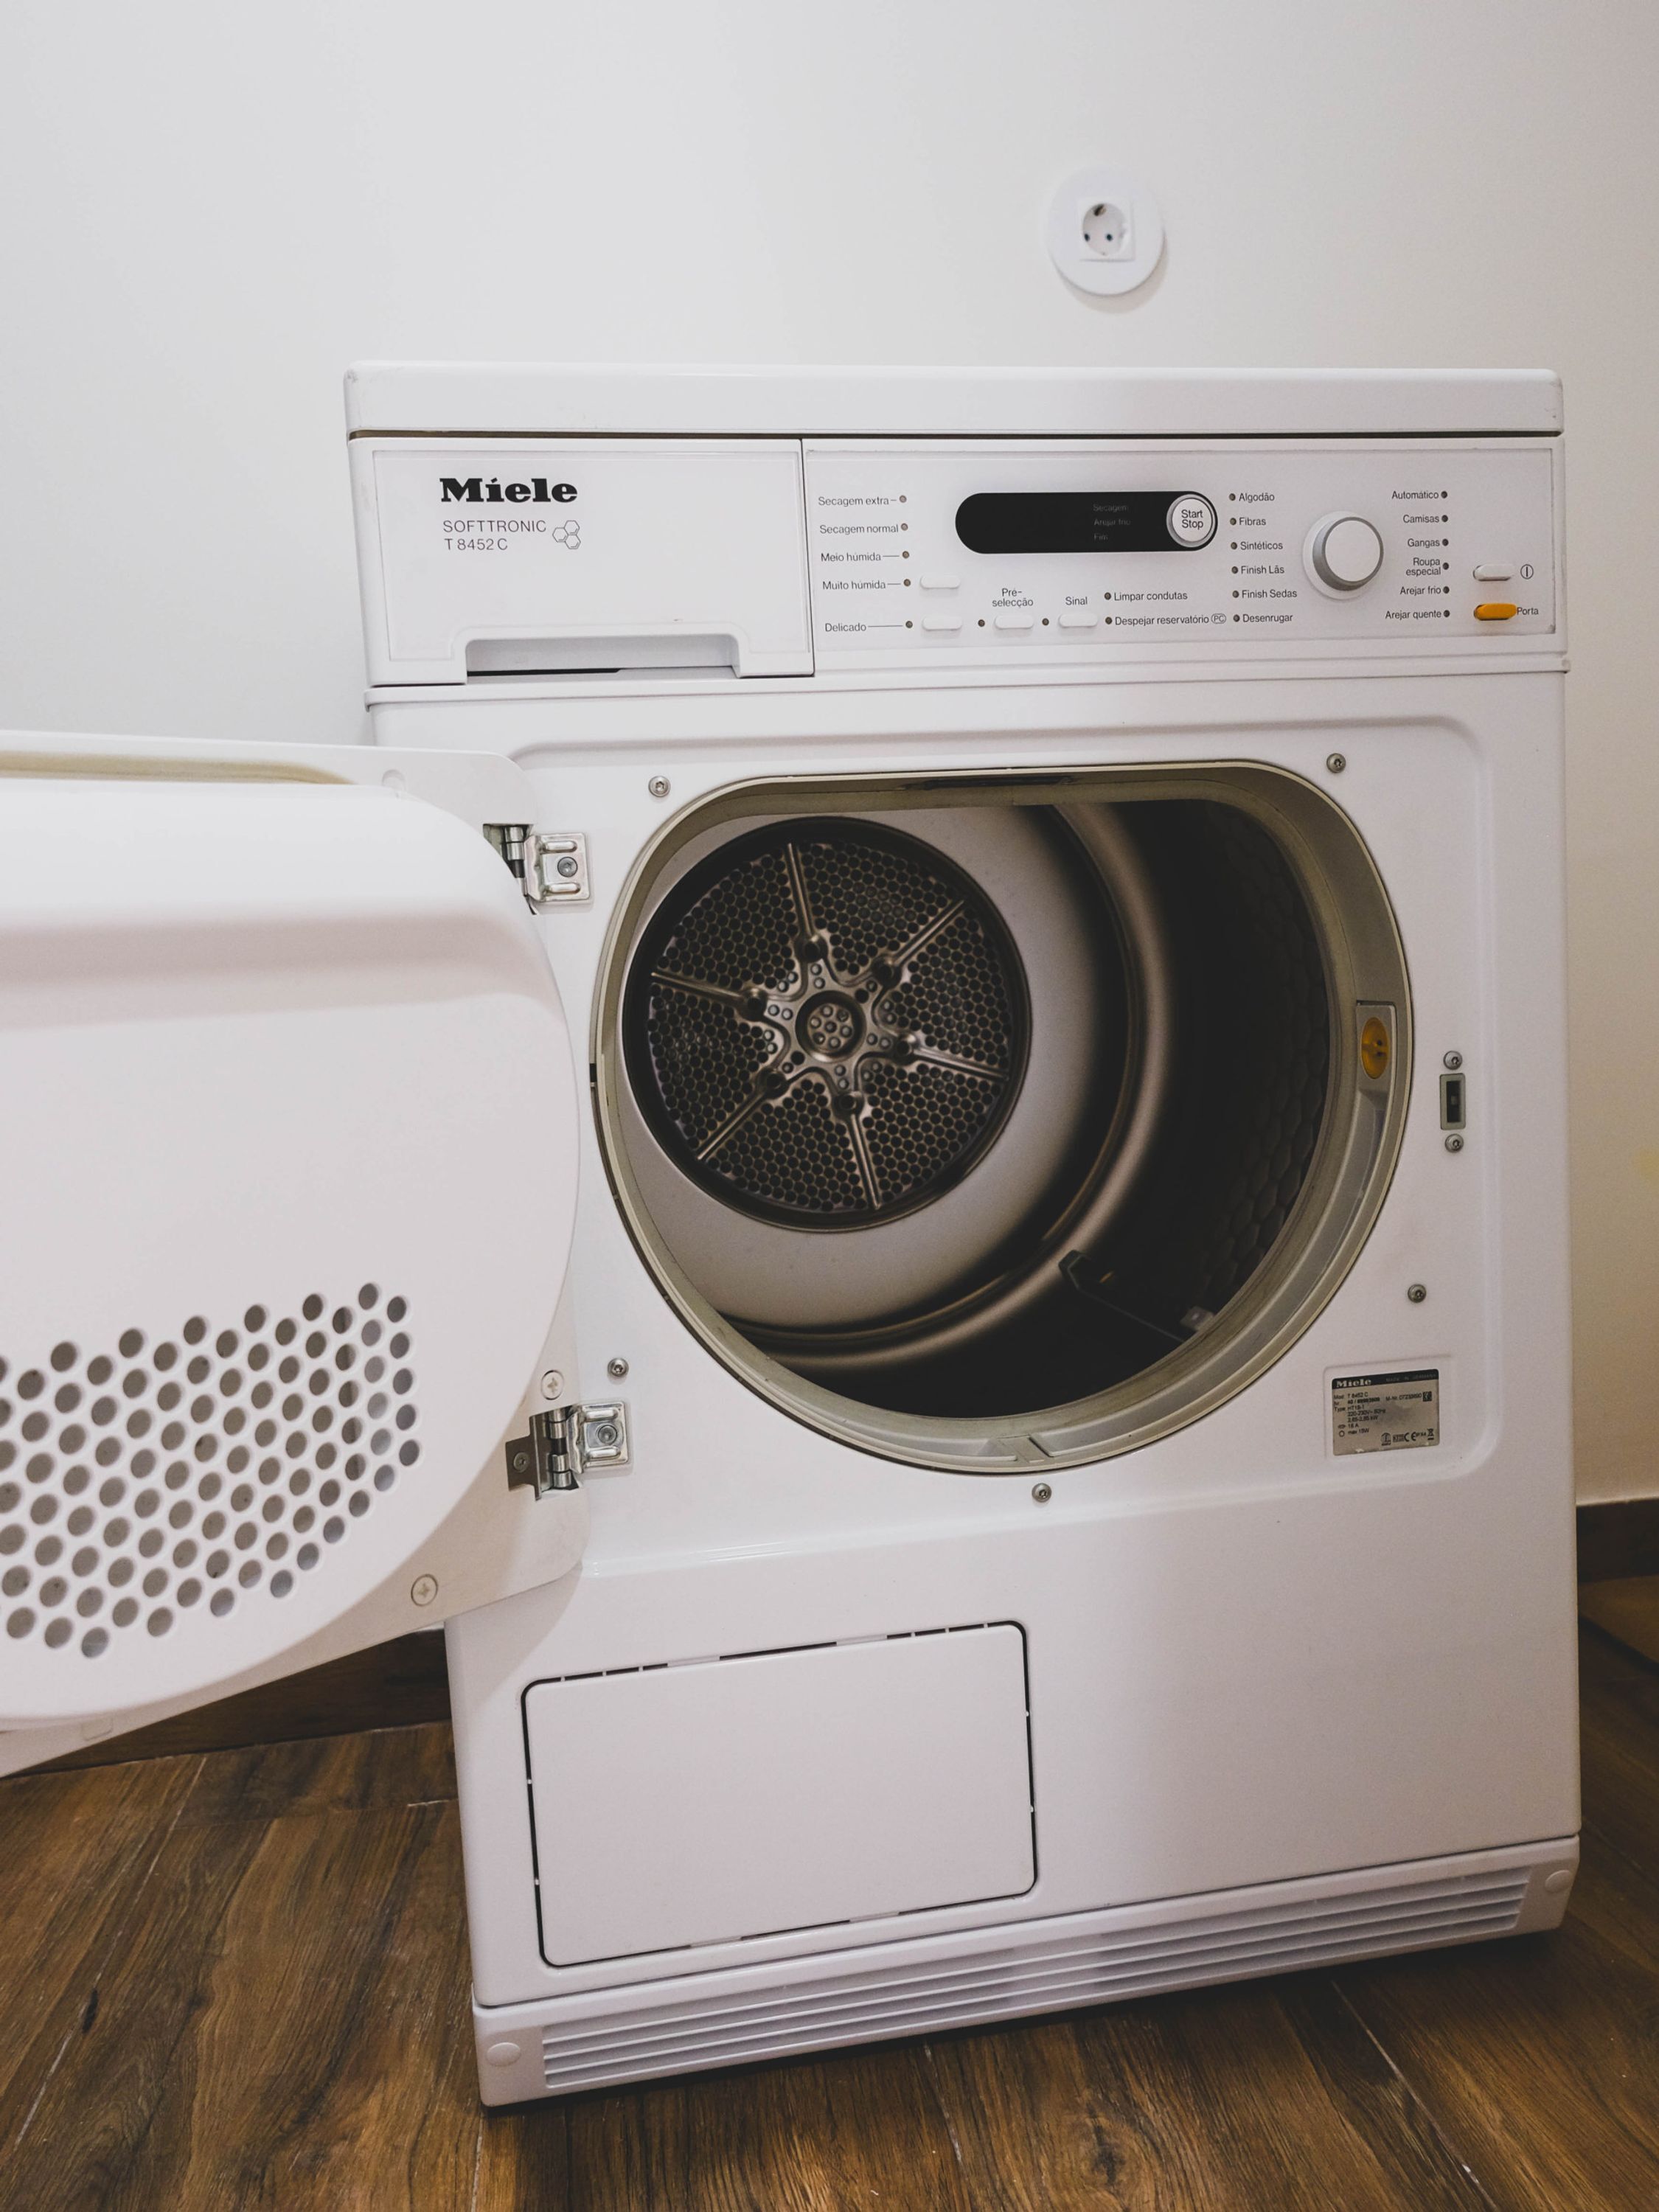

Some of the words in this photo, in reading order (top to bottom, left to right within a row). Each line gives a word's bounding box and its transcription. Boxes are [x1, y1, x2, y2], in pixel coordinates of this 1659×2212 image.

[439, 478, 578, 503] Miele
[1392, 490, 1439, 499] Automático
[818, 496, 863, 508] Secagem
[866, 497, 889, 505] extra
[1239, 493, 1275, 503] Algodão
[1181, 509, 1203, 519] Start
[1403, 515, 1440, 523] Camisas
[442, 520, 546, 532] SOFTTRONIC
[1181, 519, 1204, 530] Stop
[1239, 517, 1266, 526] Fibras
[819, 524, 865, 535] Secagem
[866, 524, 899, 533] normal
[445, 538, 453, 550] T
[457, 538, 494, 551] 8452
[497, 538, 508, 551] C
[1240, 541, 1283, 550] Sintéticos
[1408, 538, 1440, 548] Gangas
[821, 553, 844, 562] Meio
[846, 552, 881, 562] húmida
[1413, 557, 1441, 568] Roupa
[1241, 566, 1267, 574] Finish
[1269, 565, 1284, 574] Lãs
[1405, 567, 1441, 577] especial
[822, 581, 849, 590] Muito
[851, 580, 886, 589] húmida
[1001, 587, 1023, 597] Pré-
[1242, 589, 1267, 598] Finish
[1270, 589, 1297, 598] Sedas
[1400, 586, 1425, 596] Arejar
[1427, 585, 1441, 594] frio
[1065, 597, 1088, 605] Sinal
[1114, 591, 1144, 603] Limpar
[1147, 591, 1188, 601] condutas
[992, 597, 1034, 609] selecção
[1385, 611, 1411, 621] Arejar
[1413, 611, 1441, 619] quente
[1517, 607, 1539, 616] Porta
[1115, 616, 1155, 627] Despejar
[1157, 615, 1210, 625] reservatório
[1242, 614, 1293, 624] Desenrugar
[824, 622, 867, 632] Delicado
[1336, 1378, 1371, 1388] Miele
